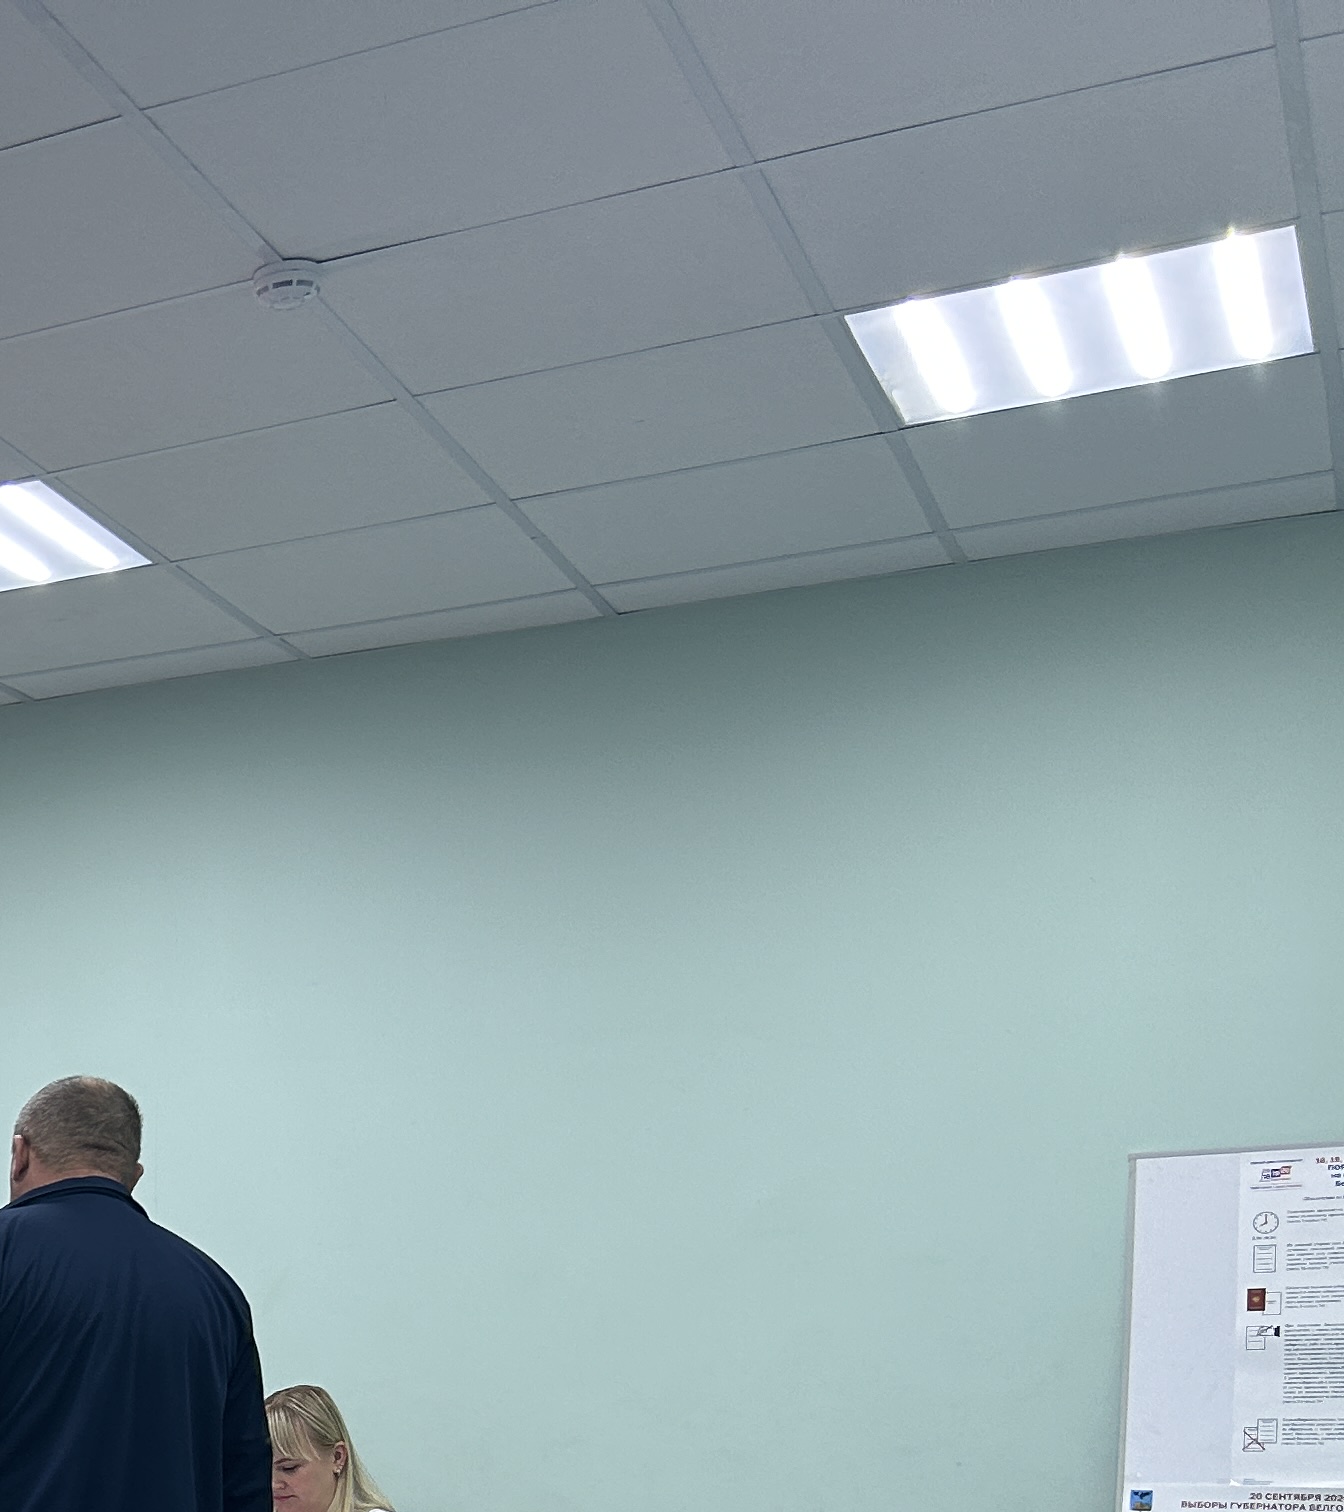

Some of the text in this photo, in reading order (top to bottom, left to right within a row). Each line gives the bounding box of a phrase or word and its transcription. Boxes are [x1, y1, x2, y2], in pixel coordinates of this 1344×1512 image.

[1264, 1492, 1322, 1502] СЕНТЯБРЯ
[1323, 1494, 1344, 1502] 202
[1180, 1500, 1228, 1510] ВЫБОРЫ
[1230, 1501, 1307, 1512] ГУБЕРНАТОРА
